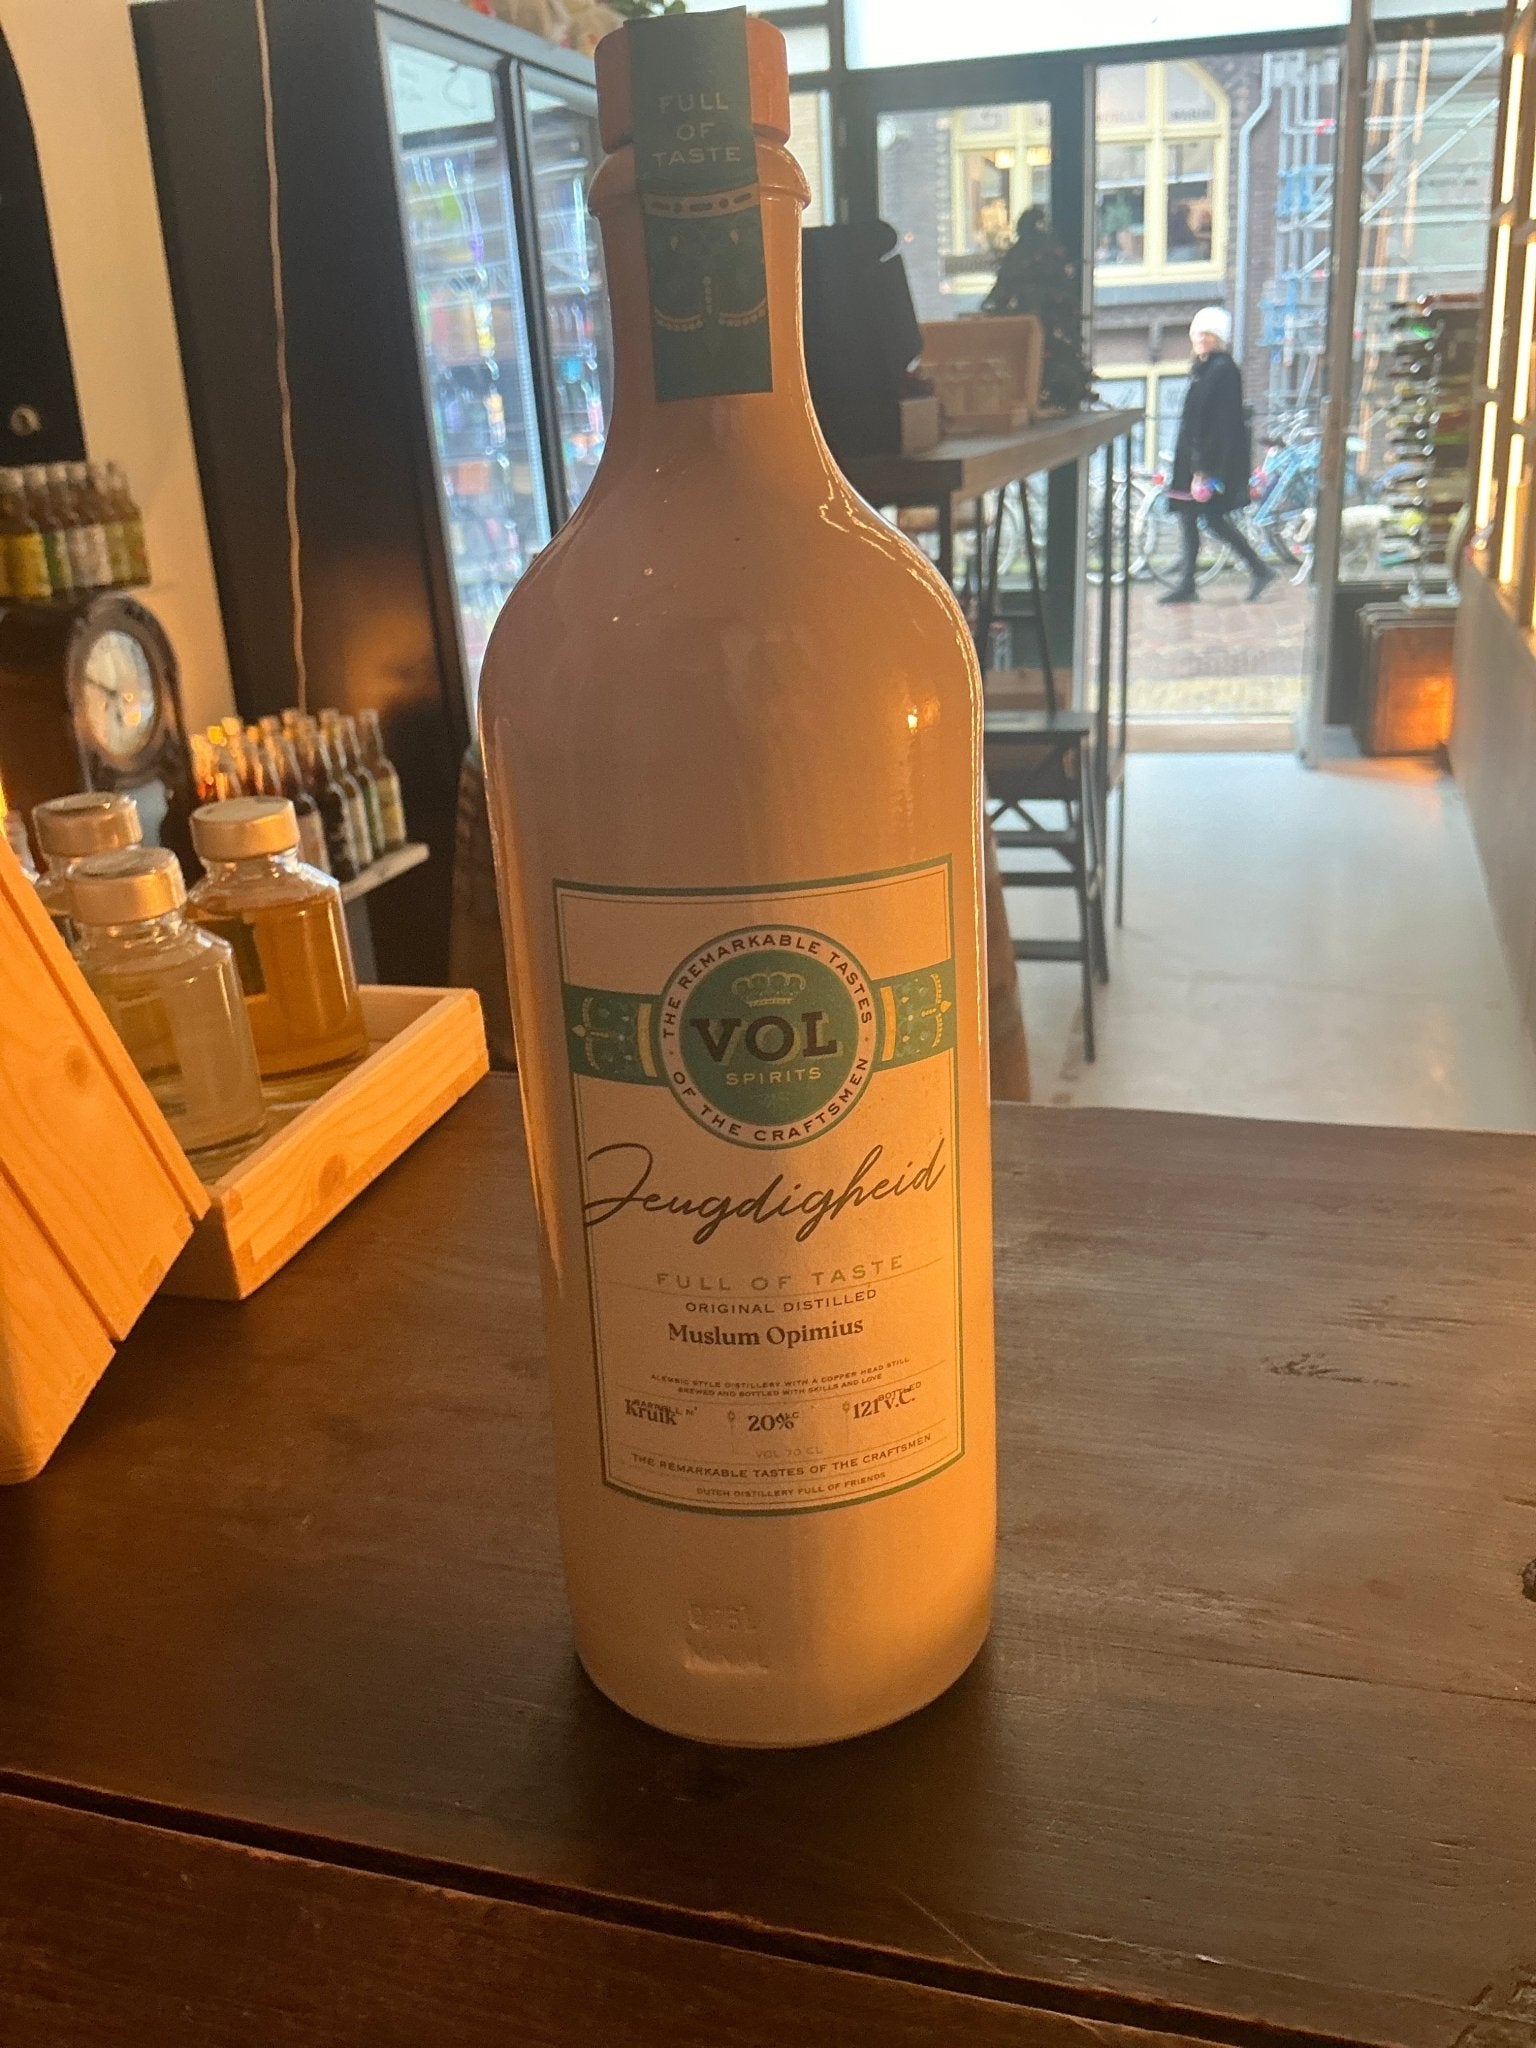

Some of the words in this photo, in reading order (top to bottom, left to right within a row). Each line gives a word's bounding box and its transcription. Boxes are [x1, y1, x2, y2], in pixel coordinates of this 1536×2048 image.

[658, 92, 729, 114] FULL
[676, 122, 716, 141] OF
[651, 146, 741, 168] TASTE
[663, 996, 682, 1039] THE
[677, 934, 821, 989] REMARKABLE
[829, 951, 873, 1024] TASTES
[690, 1010, 841, 1064] VOL
[725, 1066, 823, 1086] SPIRITS
[673, 1071, 697, 1098] OF
[701, 1104, 742, 1135] THE
[754, 1058, 869, 1141] CRAFTSMEN
[583, 1137, 946, 1245] Jeugdigheid
[656, 1272, 731, 1291] FULL
[750, 1274, 791, 1291] OF
[811, 1255, 903, 1286] TASTE
[685, 1302, 775, 1314] ORIGINAL
[783, 1289, 877, 1312] DISTILLED
[668, 1322, 761, 1346] Muslum
[766, 1319, 864, 1349] Opimius
[692, 1380, 721, 1388] STYLE
[724, 1381, 781, 1389] DISTILLERY
[784, 1378, 809, 1387] WITH
[821, 1371, 857, 1383] COPPER
[860, 1364, 884, 1375] HEAD
[886, 1357, 910, 1369] STILL
[782, 1387, 806, 1396] WITH
[808, 1383, 839, 1394] SKILLS
[841, 1379, 860, 1389] AND
[862, 1373, 882, 1384] LOVE
[748, 1413, 794, 1432] 20%
[631, 1453, 656, 1468] THE
[660, 1460, 749, 1478] REMARKABLE
[753, 1467, 805, 1478] TASTES
[810, 1464, 828, 1474] OF
[831, 1457, 859, 1471] THE
[862, 1433, 931, 1463] CRAFTSMEN
[697, 1487, 731, 1497] DUTCH
[733, 1488, 794, 1498] DISTILLERY
[798, 1486, 825, 1495] FULL
[827, 1482, 840, 1491] OF
[844, 1471, 886, 1488] FRIENDS
